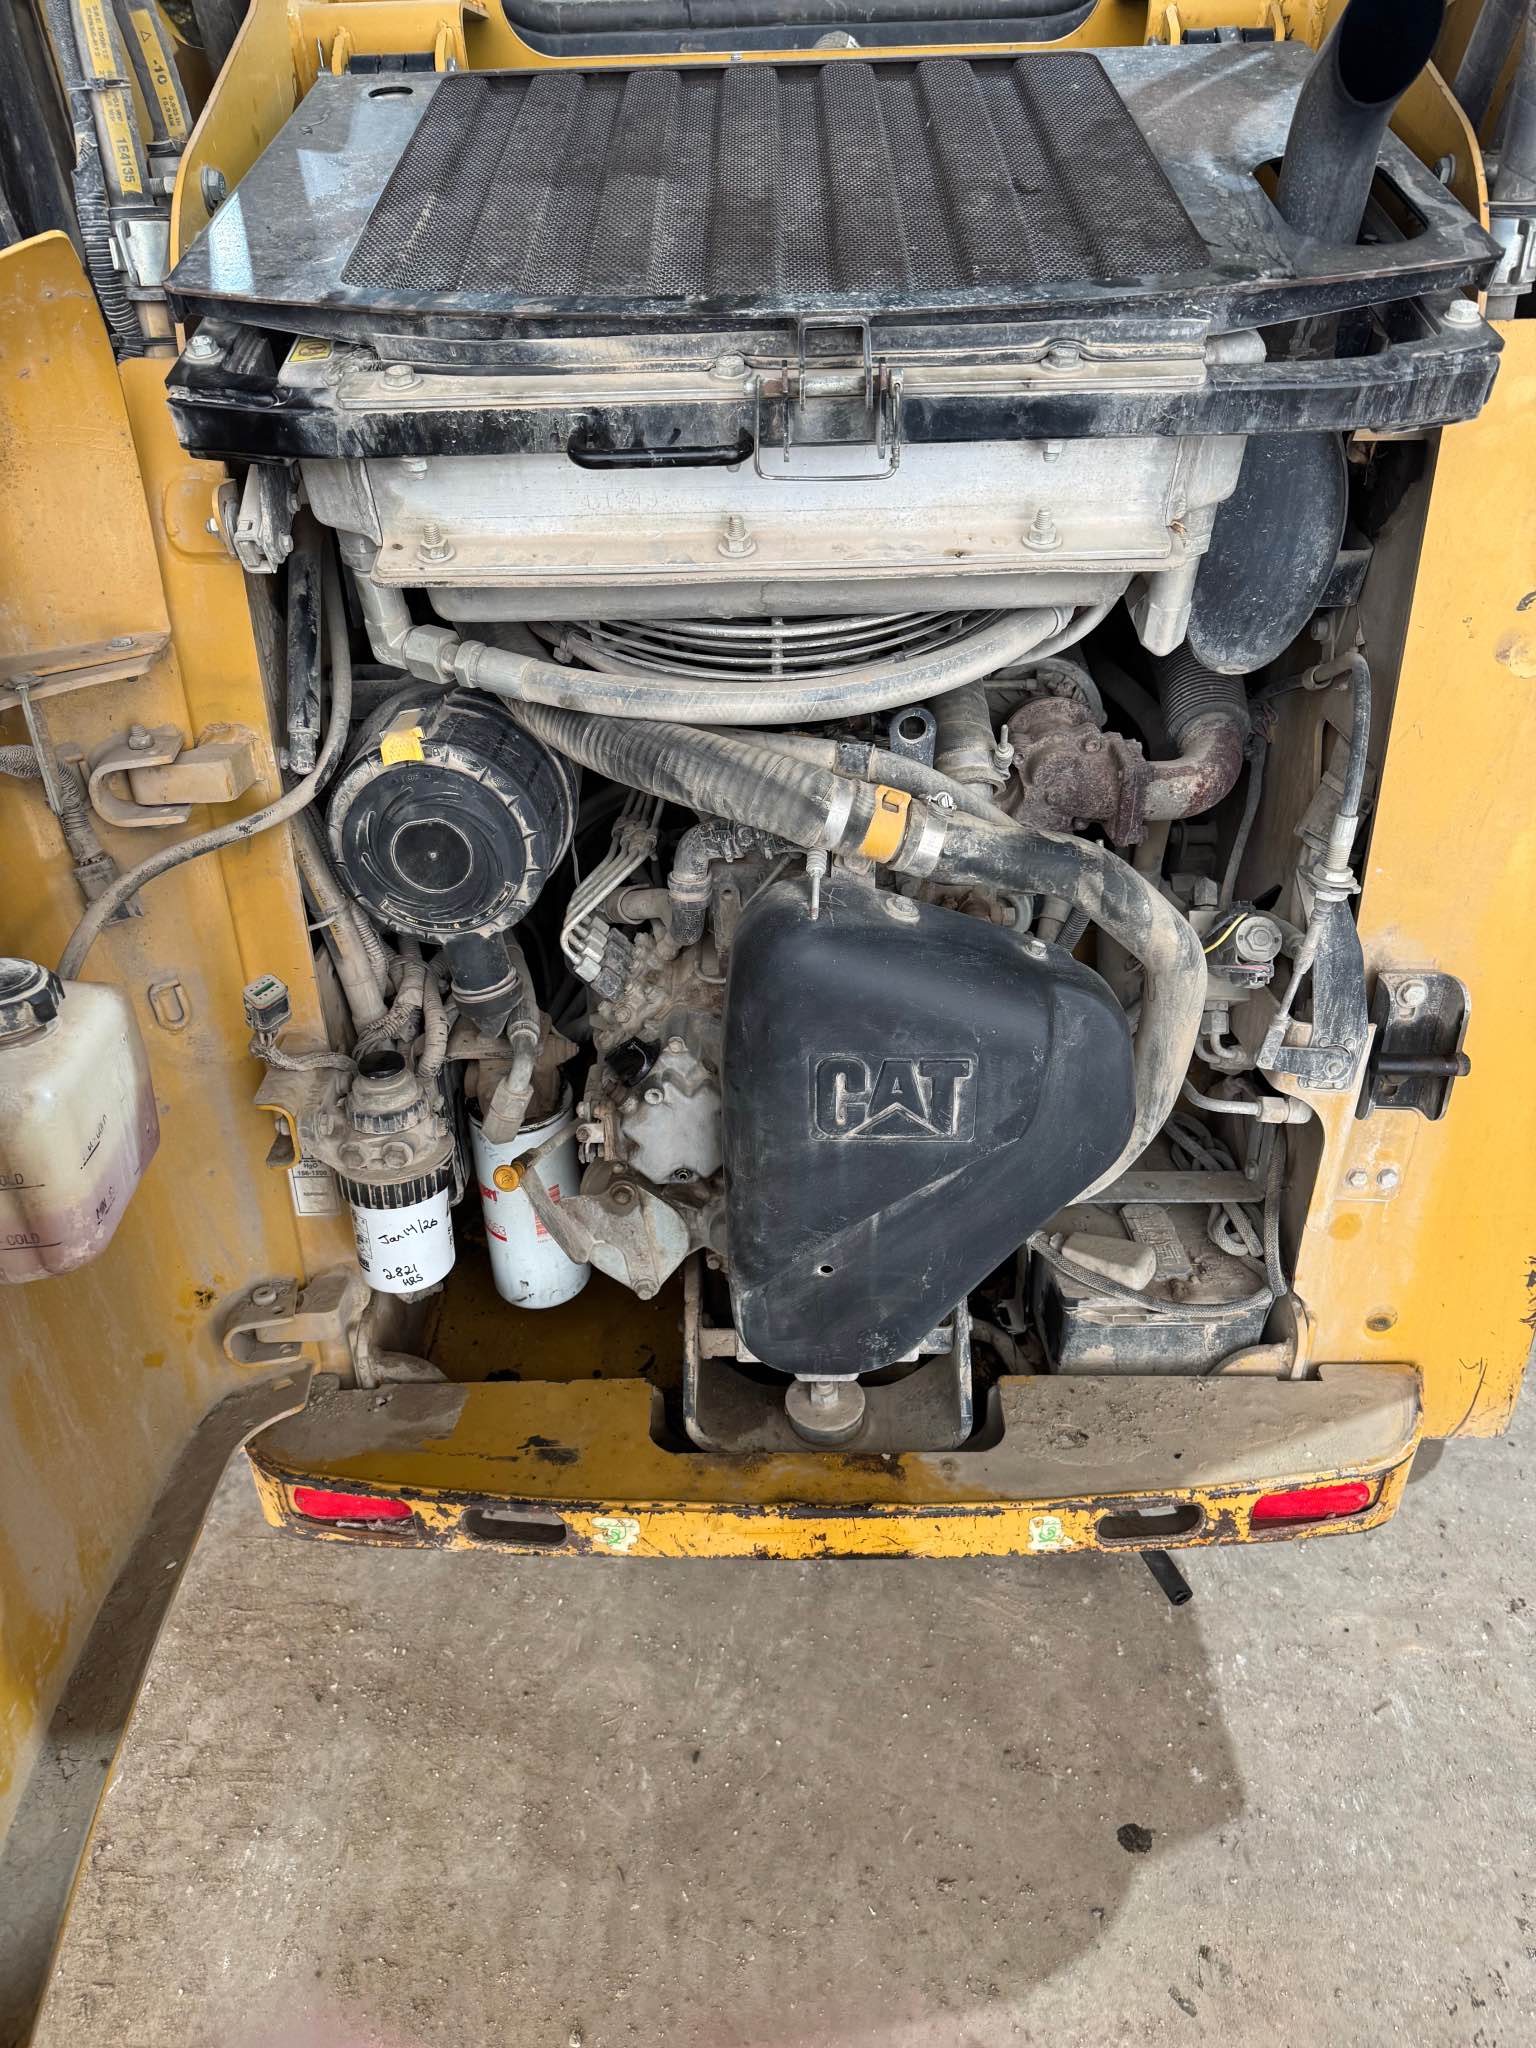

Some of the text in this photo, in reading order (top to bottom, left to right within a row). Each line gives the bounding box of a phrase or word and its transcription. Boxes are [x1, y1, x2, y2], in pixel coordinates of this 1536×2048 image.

[116, 136, 136, 183] 1E4135
[815, 1056, 974, 1137] CAT
[6, 1232, 40, 1246] COLD
[382, 1263, 418, 1280] 2821
[402, 1273, 424, 1286] HRS
